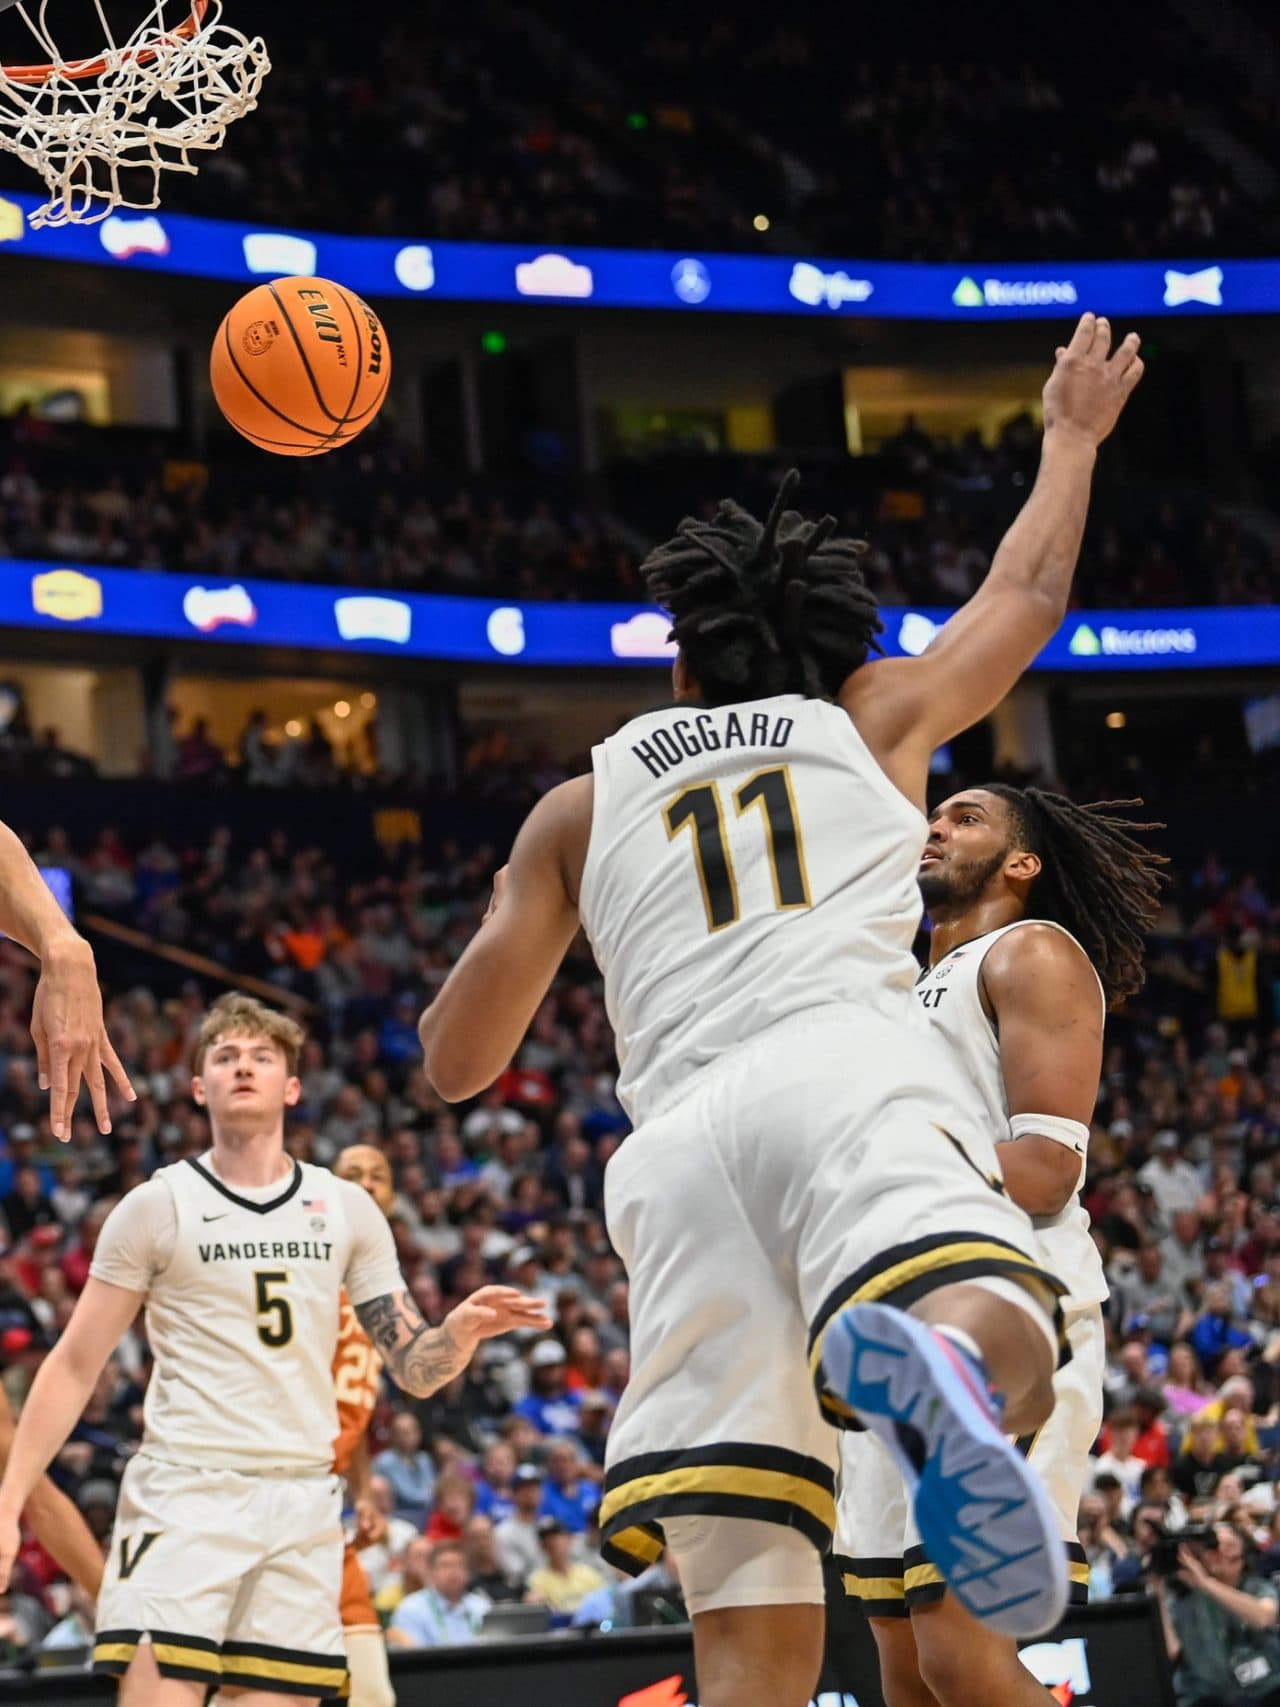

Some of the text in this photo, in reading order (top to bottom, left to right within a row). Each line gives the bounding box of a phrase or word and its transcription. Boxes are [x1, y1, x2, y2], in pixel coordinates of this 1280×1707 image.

[297, 289, 348, 369] EVO NXT
[631, 712, 794, 779] HOGGARD
[661, 764, 814, 934] 11
[199, 1241, 333, 1263] VANDERBILT
[252, 1270, 296, 1349] 5
